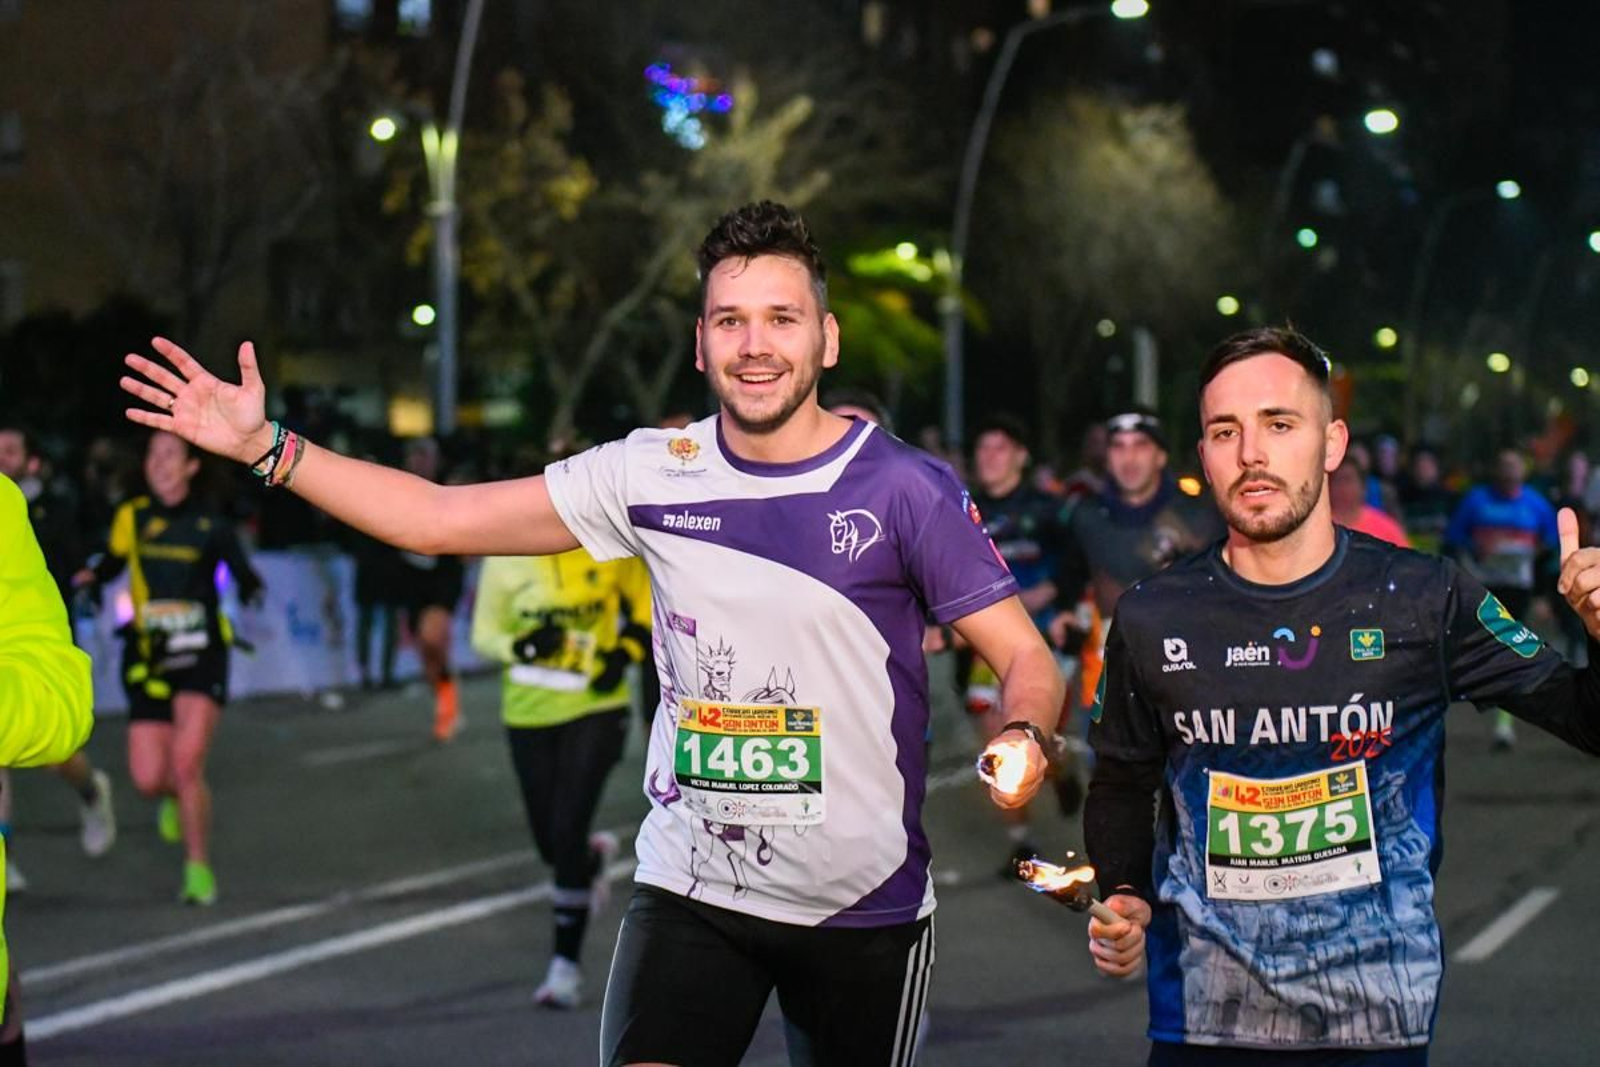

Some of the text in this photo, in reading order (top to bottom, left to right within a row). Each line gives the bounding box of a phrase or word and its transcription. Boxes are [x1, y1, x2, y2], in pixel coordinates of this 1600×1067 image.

[675, 510, 721, 531] alexen
[698, 706, 722, 728] 42
[1173, 692, 1394, 745] SAN ANTÓN
[683, 733, 810, 780] 1463
[711, 781, 737, 790] MANUEL
[739, 782, 759, 791] LOPEZ
[761, 783, 799, 791] COLORADO
[1235, 785, 1261, 807] 42
[1218, 799, 1358, 856] 1375
[1230, 846, 1348, 867] JUAN MANUEL MATEOS QUESADA
